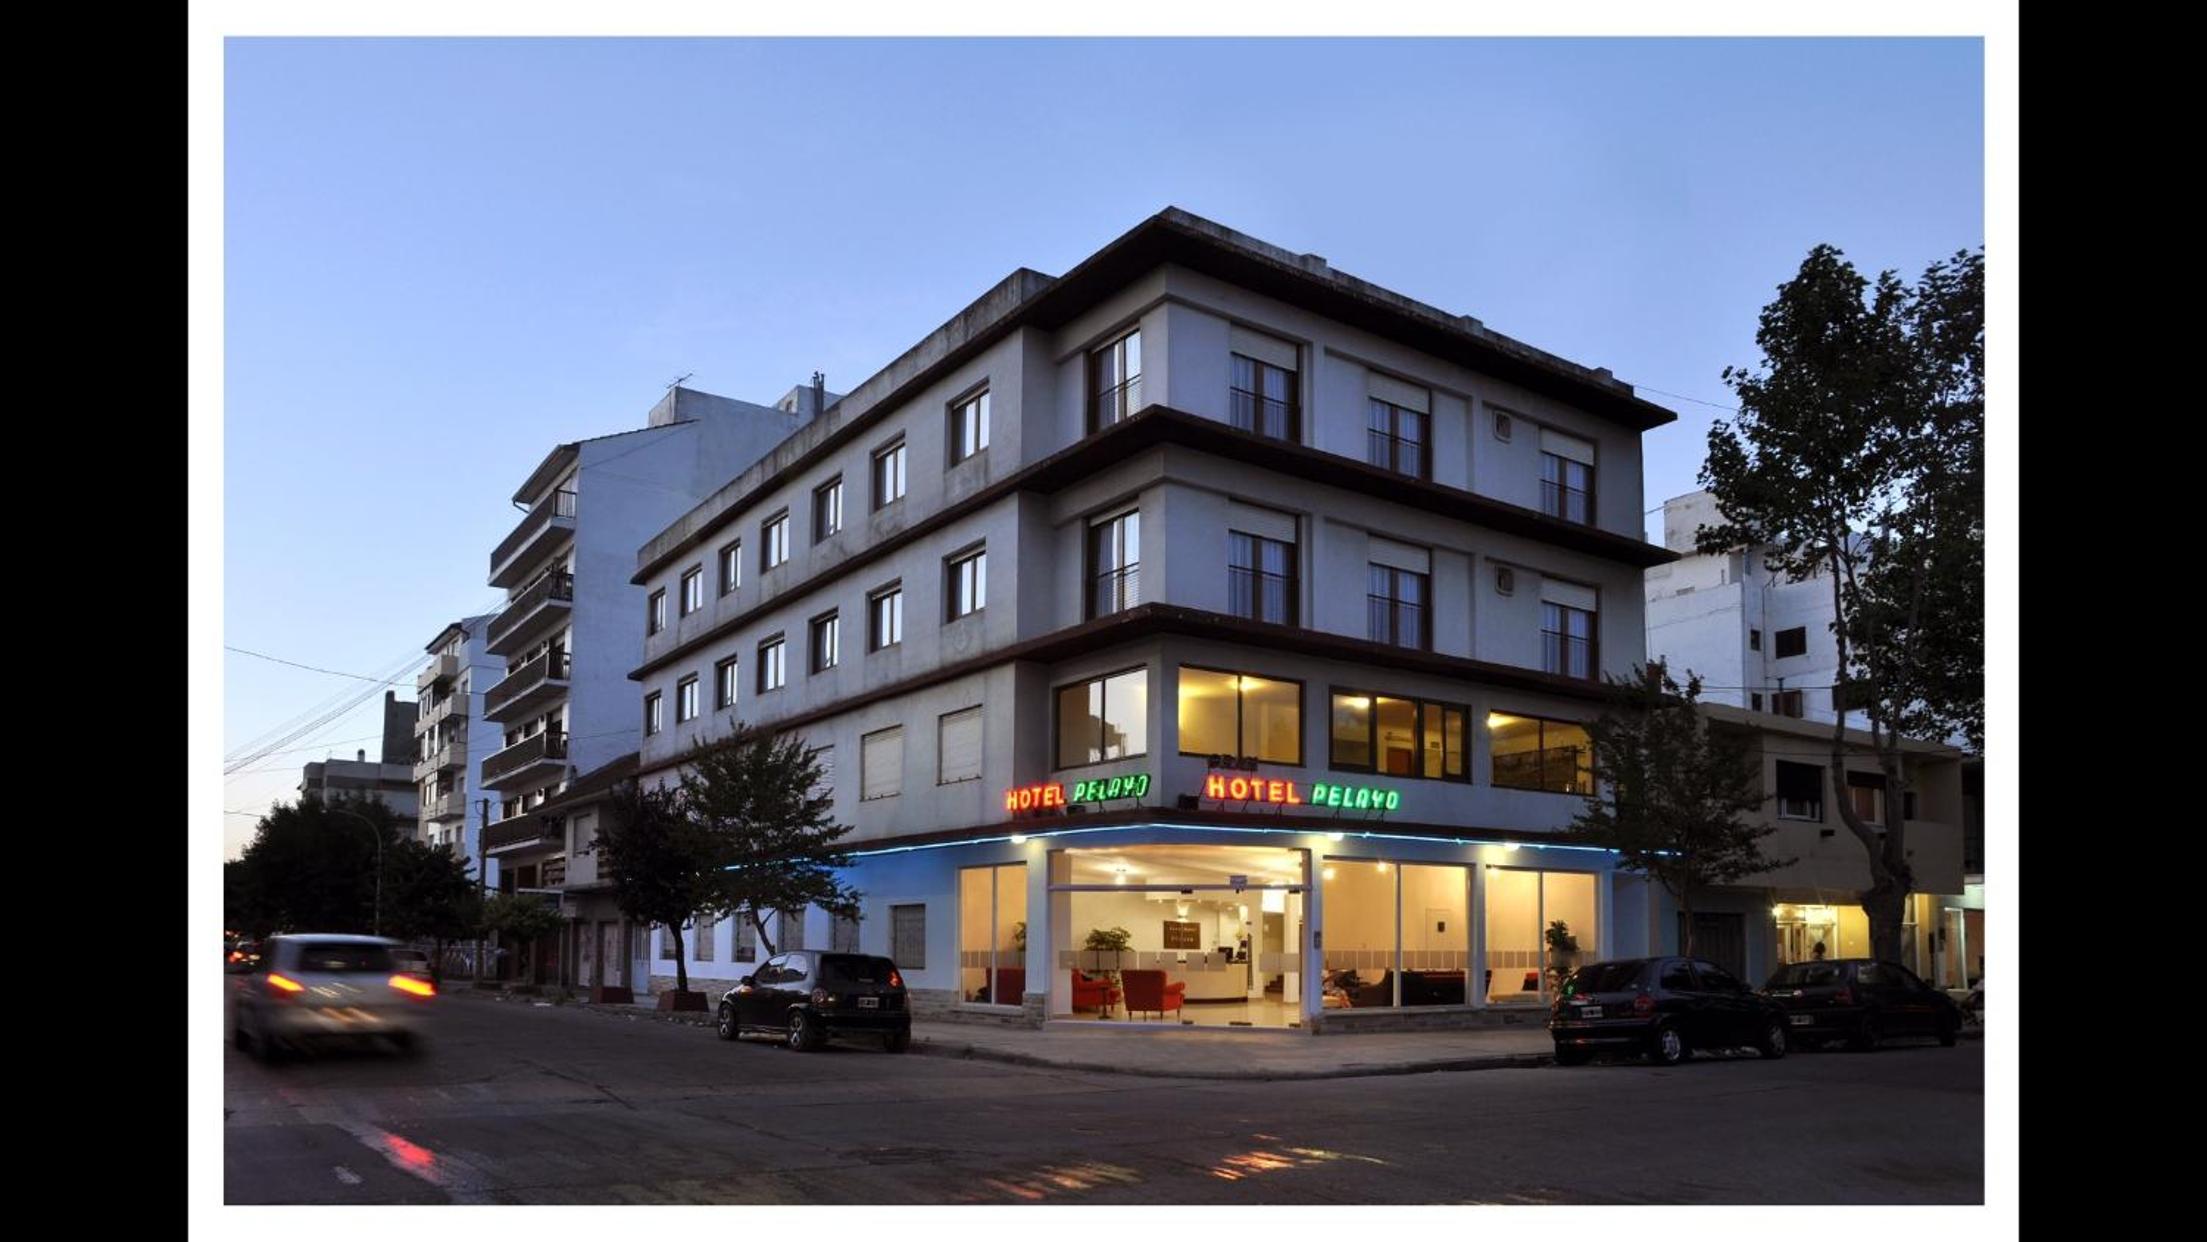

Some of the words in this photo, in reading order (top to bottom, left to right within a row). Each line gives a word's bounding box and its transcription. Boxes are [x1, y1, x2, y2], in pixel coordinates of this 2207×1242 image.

[1006, 785, 1064, 809] HOTEL
[1073, 774, 1150, 802] PELAYO
[1207, 775, 1299, 804] HOTEL
[1313, 784, 1400, 811] PELAYO
